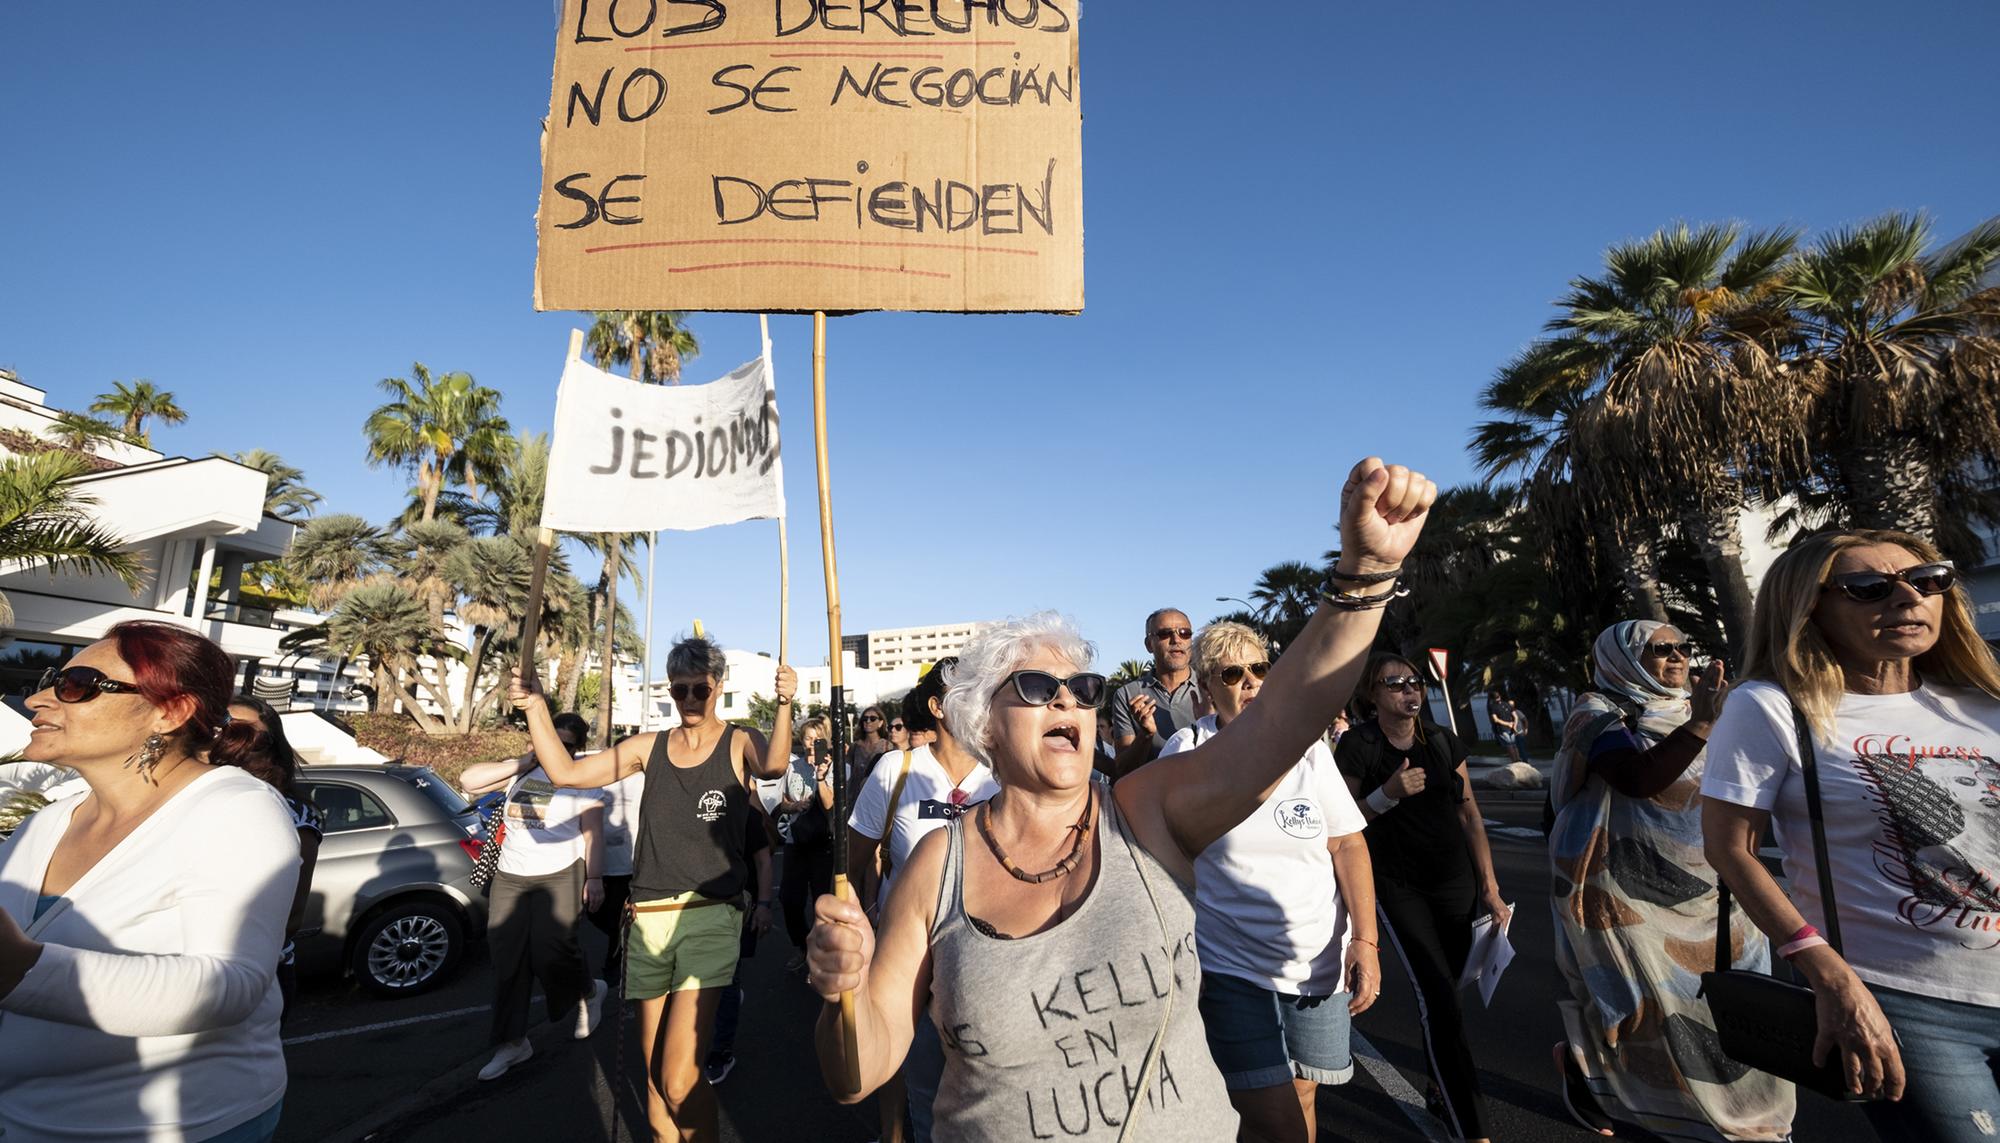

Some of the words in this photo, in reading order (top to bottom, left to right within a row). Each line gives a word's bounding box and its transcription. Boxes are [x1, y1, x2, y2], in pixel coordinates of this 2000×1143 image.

[567, 66, 668, 128] NO
[707, 64, 802, 115] SE
[554, 172, 647, 229] SE
[1054, 1020, 1119, 1069] EN
[1026, 1049, 1183, 1140] LUCHA
